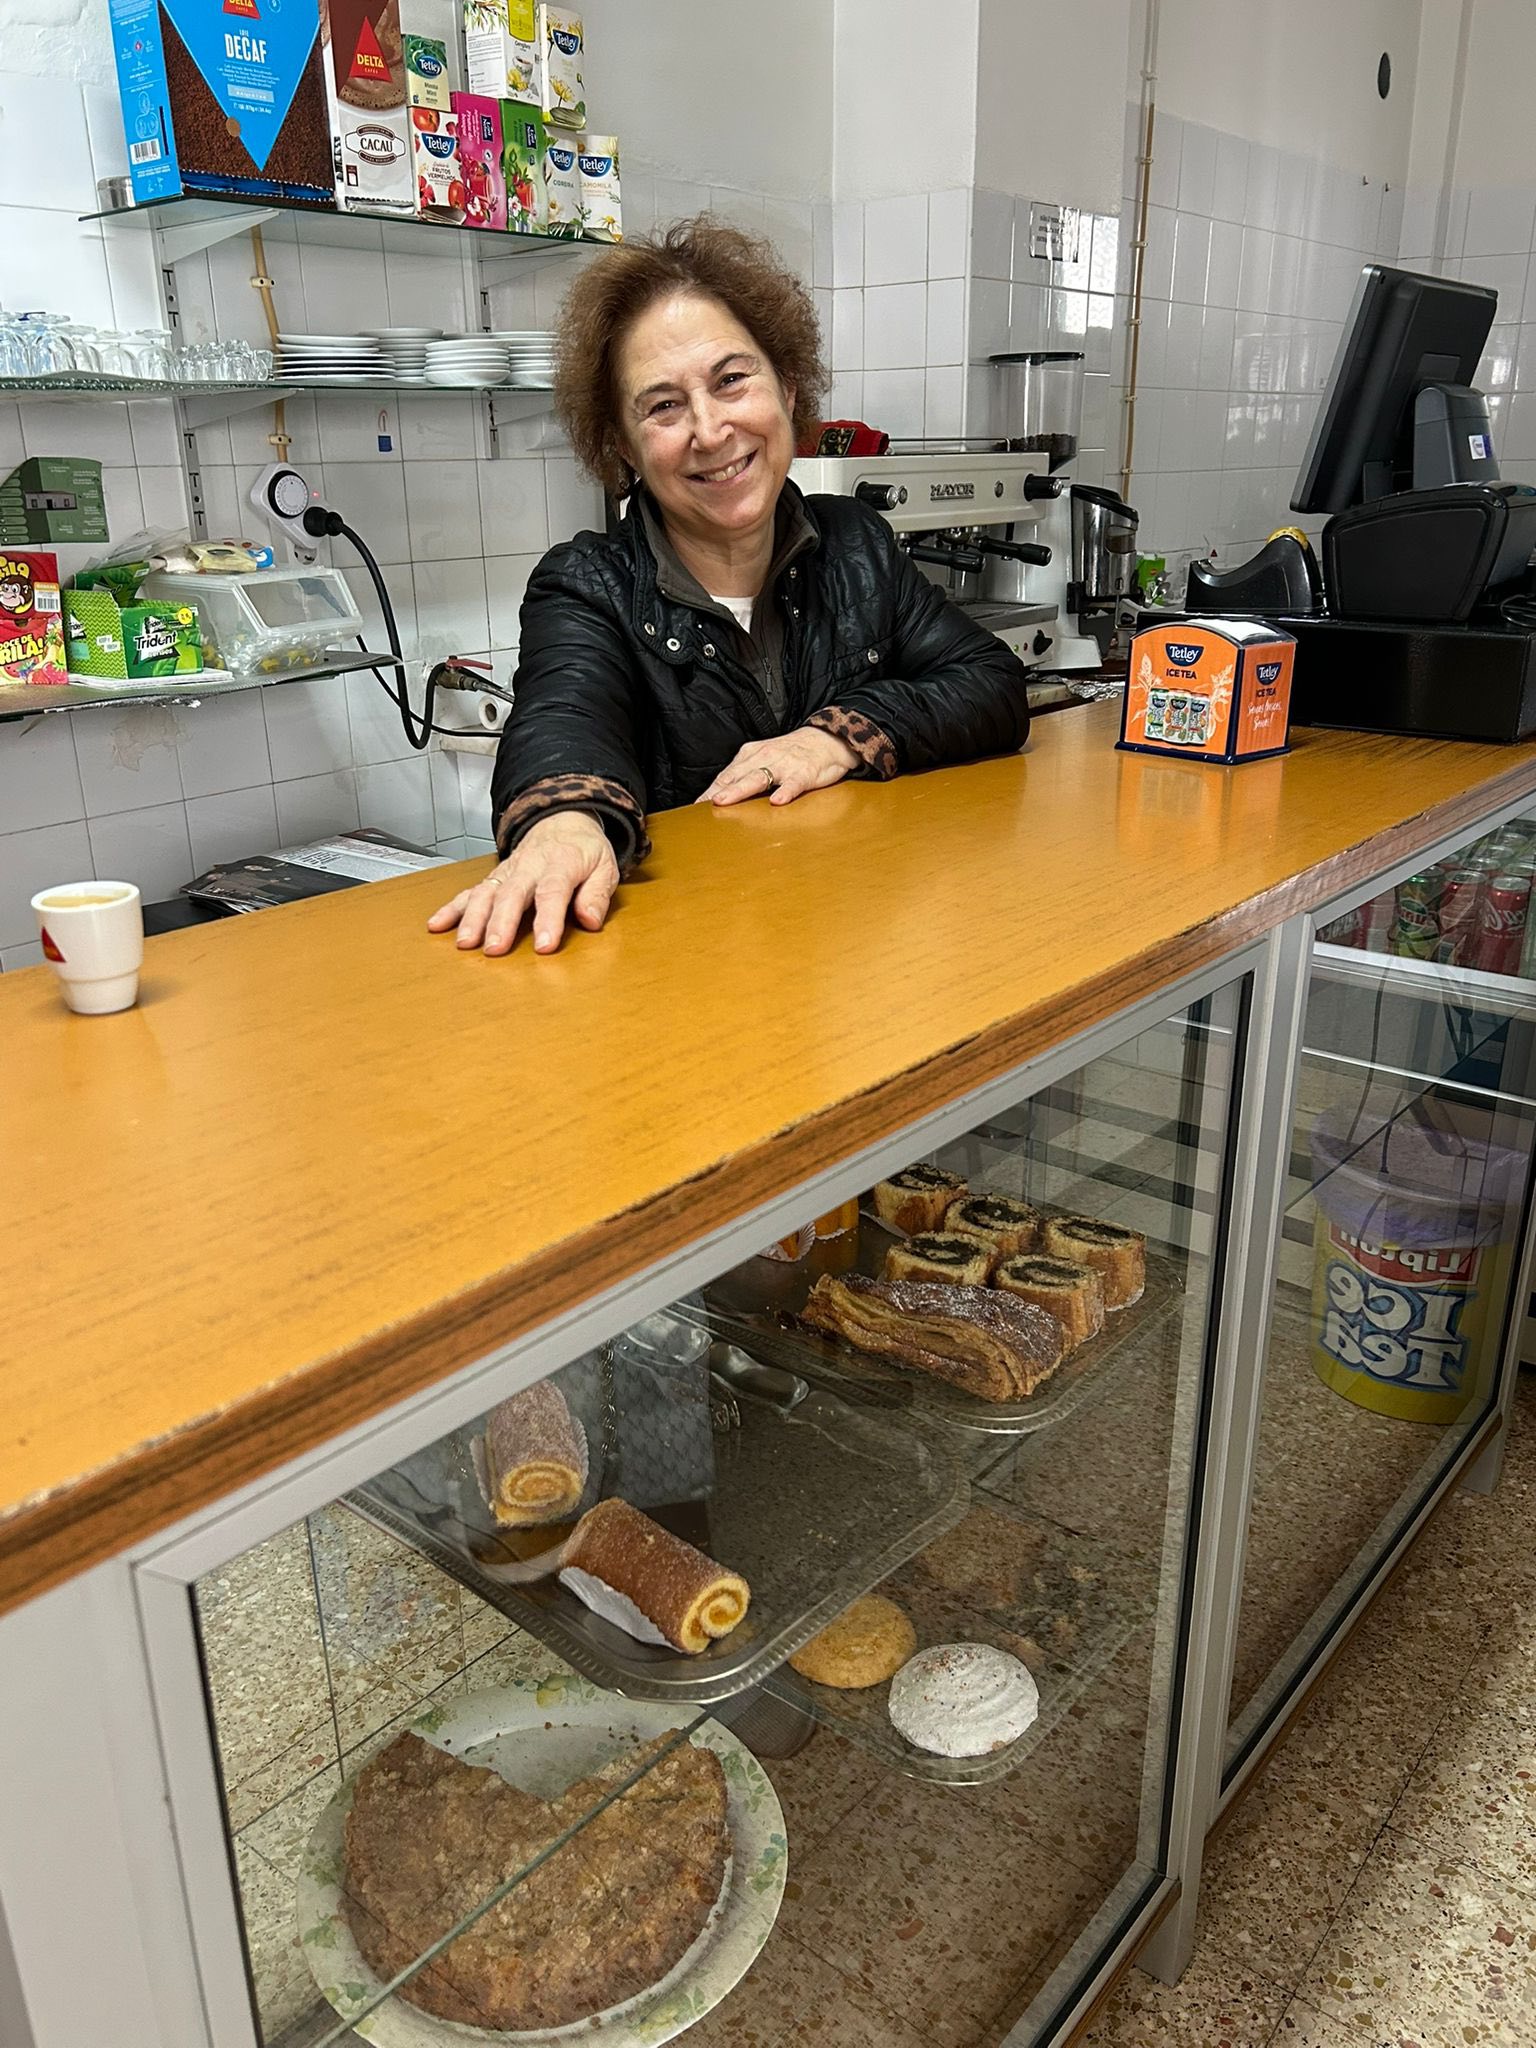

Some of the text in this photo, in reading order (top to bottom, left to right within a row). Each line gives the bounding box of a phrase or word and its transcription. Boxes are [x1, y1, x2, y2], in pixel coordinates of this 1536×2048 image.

[224, 33, 267, 64] DECAF
[556, 32, 577, 51] Tetley
[356, 53, 385, 68] DELTA
[419, 58, 441, 74] Tetley
[360, 137, 393, 152] CACAU
[425, 135, 452, 155] Tetley
[551, 150, 572, 168] Tetley
[580, 158, 609, 173] Tetley
[134, 631, 177, 650] Trident
[0, 637, 44, 665] RILA!
[1169, 645, 1199, 663] Tetley
[1166, 667, 1198, 680] ICE TEA
[1258, 665, 1279, 680] Tetley
